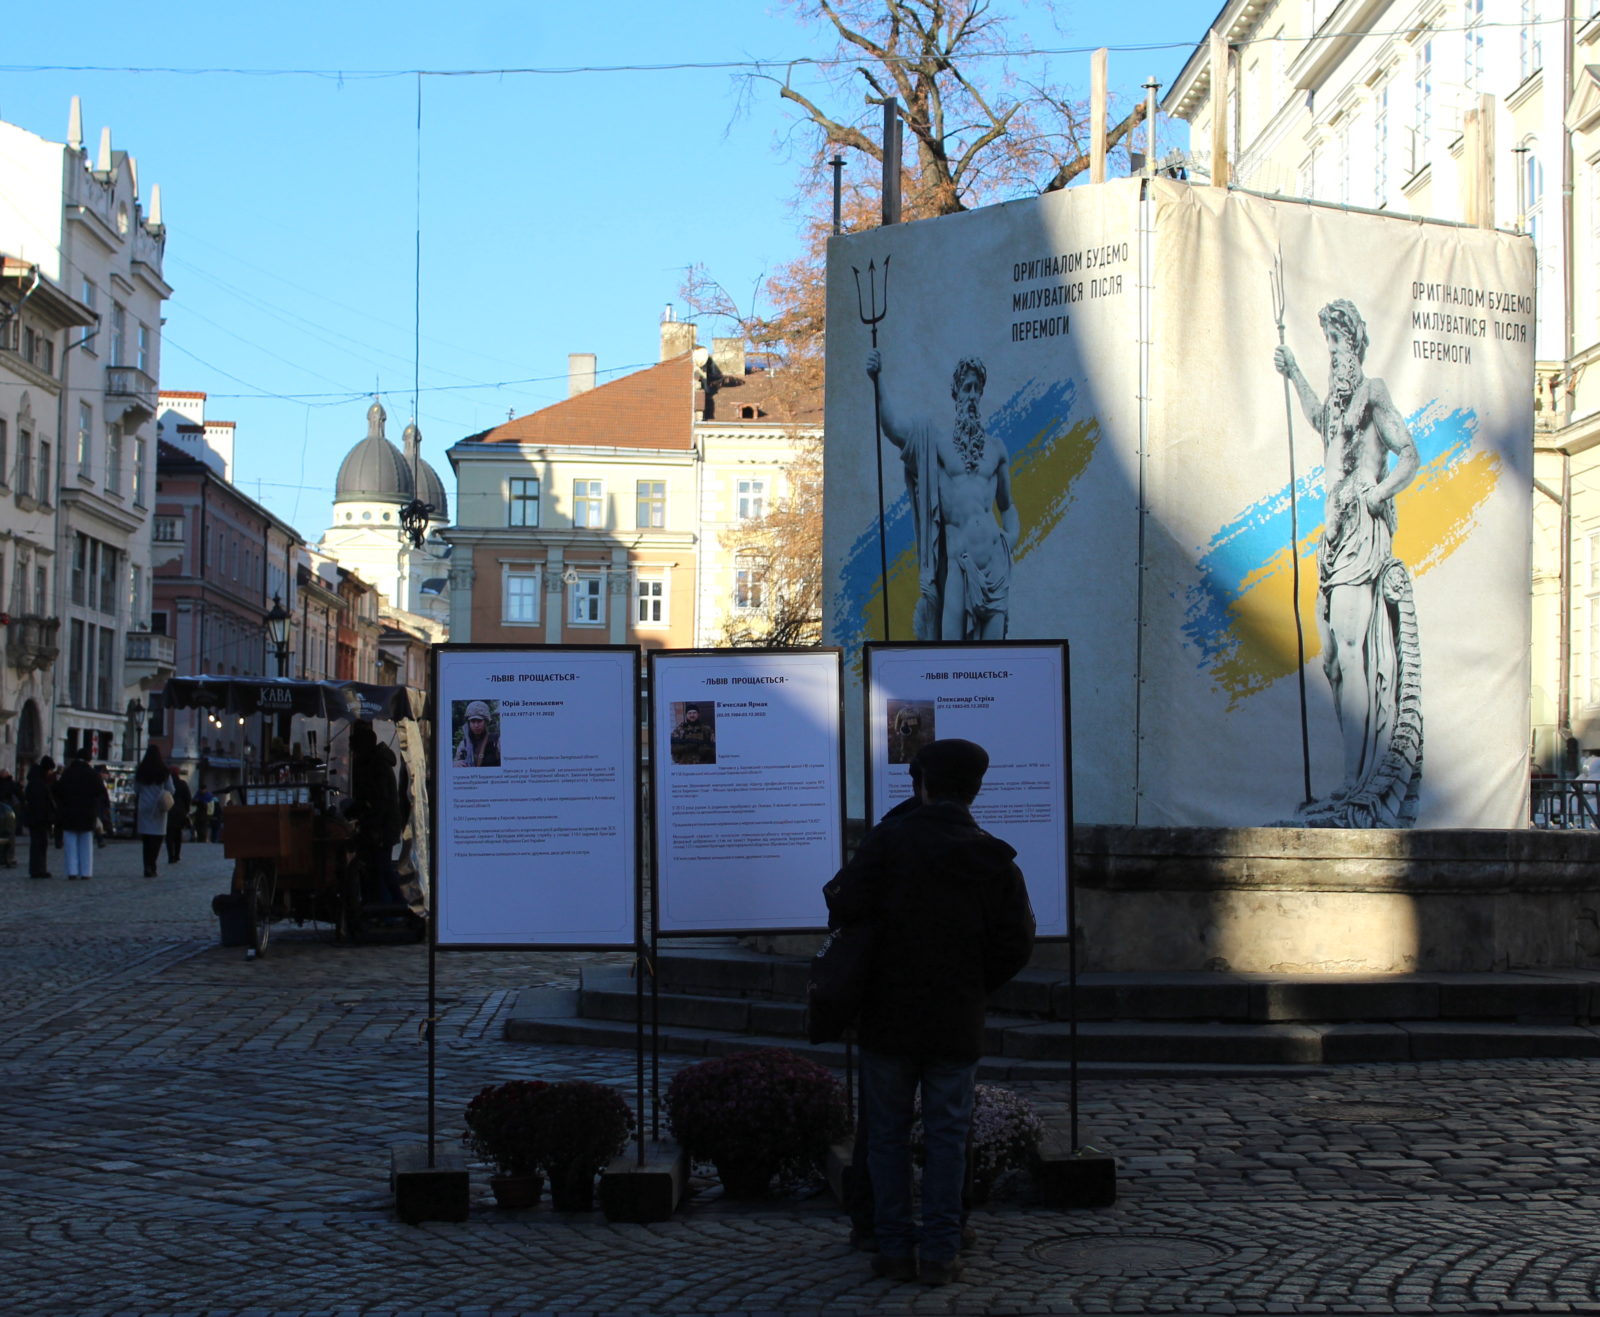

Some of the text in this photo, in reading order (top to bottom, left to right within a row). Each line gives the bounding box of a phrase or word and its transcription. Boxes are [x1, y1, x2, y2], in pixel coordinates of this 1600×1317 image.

[1013, 242, 1128, 282] ОРИГІНАЛОМ БУДЕМО
[1012, 275, 1122, 312] МИЛУВАТИСЯ ПІСЛЯ
[1412, 281, 1532, 315] ОРИГІНАЛОМ БУДЕМО
[1012, 315, 1070, 342] ПЕРЕМОГИ
[1412, 311, 1527, 343] МИЛУВАТИСЯ ПІСЛЯ
[1413, 340, 1471, 365] ПЕРЕМОГИ
[502, 700, 520, 708] Юрій
